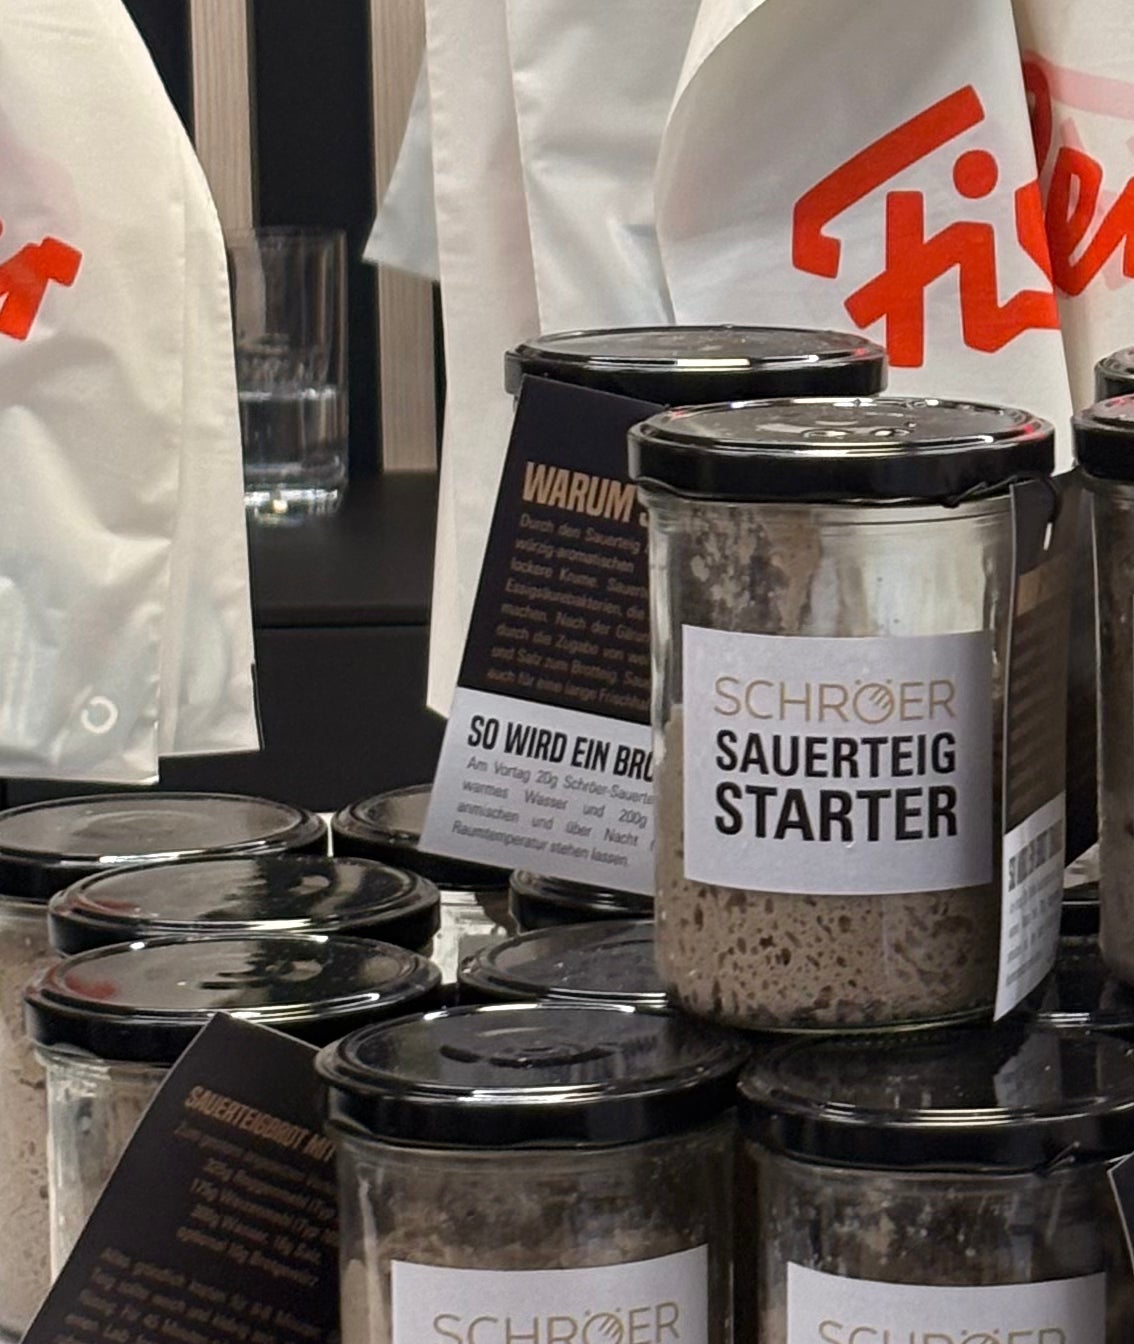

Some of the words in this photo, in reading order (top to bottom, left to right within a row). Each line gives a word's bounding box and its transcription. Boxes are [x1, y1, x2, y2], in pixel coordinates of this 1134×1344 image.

[519, 461, 637, 524] WARUM
[713, 676, 957, 724] SCHRÖER
[466, 713, 501, 750] SO
[502, 721, 568, 765] WIRD
[569, 735, 610, 775] EIN
[715, 729, 957, 778] SAUERTEIG
[562, 775, 653, 807] Schröer-Sauerte
[714, 781, 958, 842] STARTER
